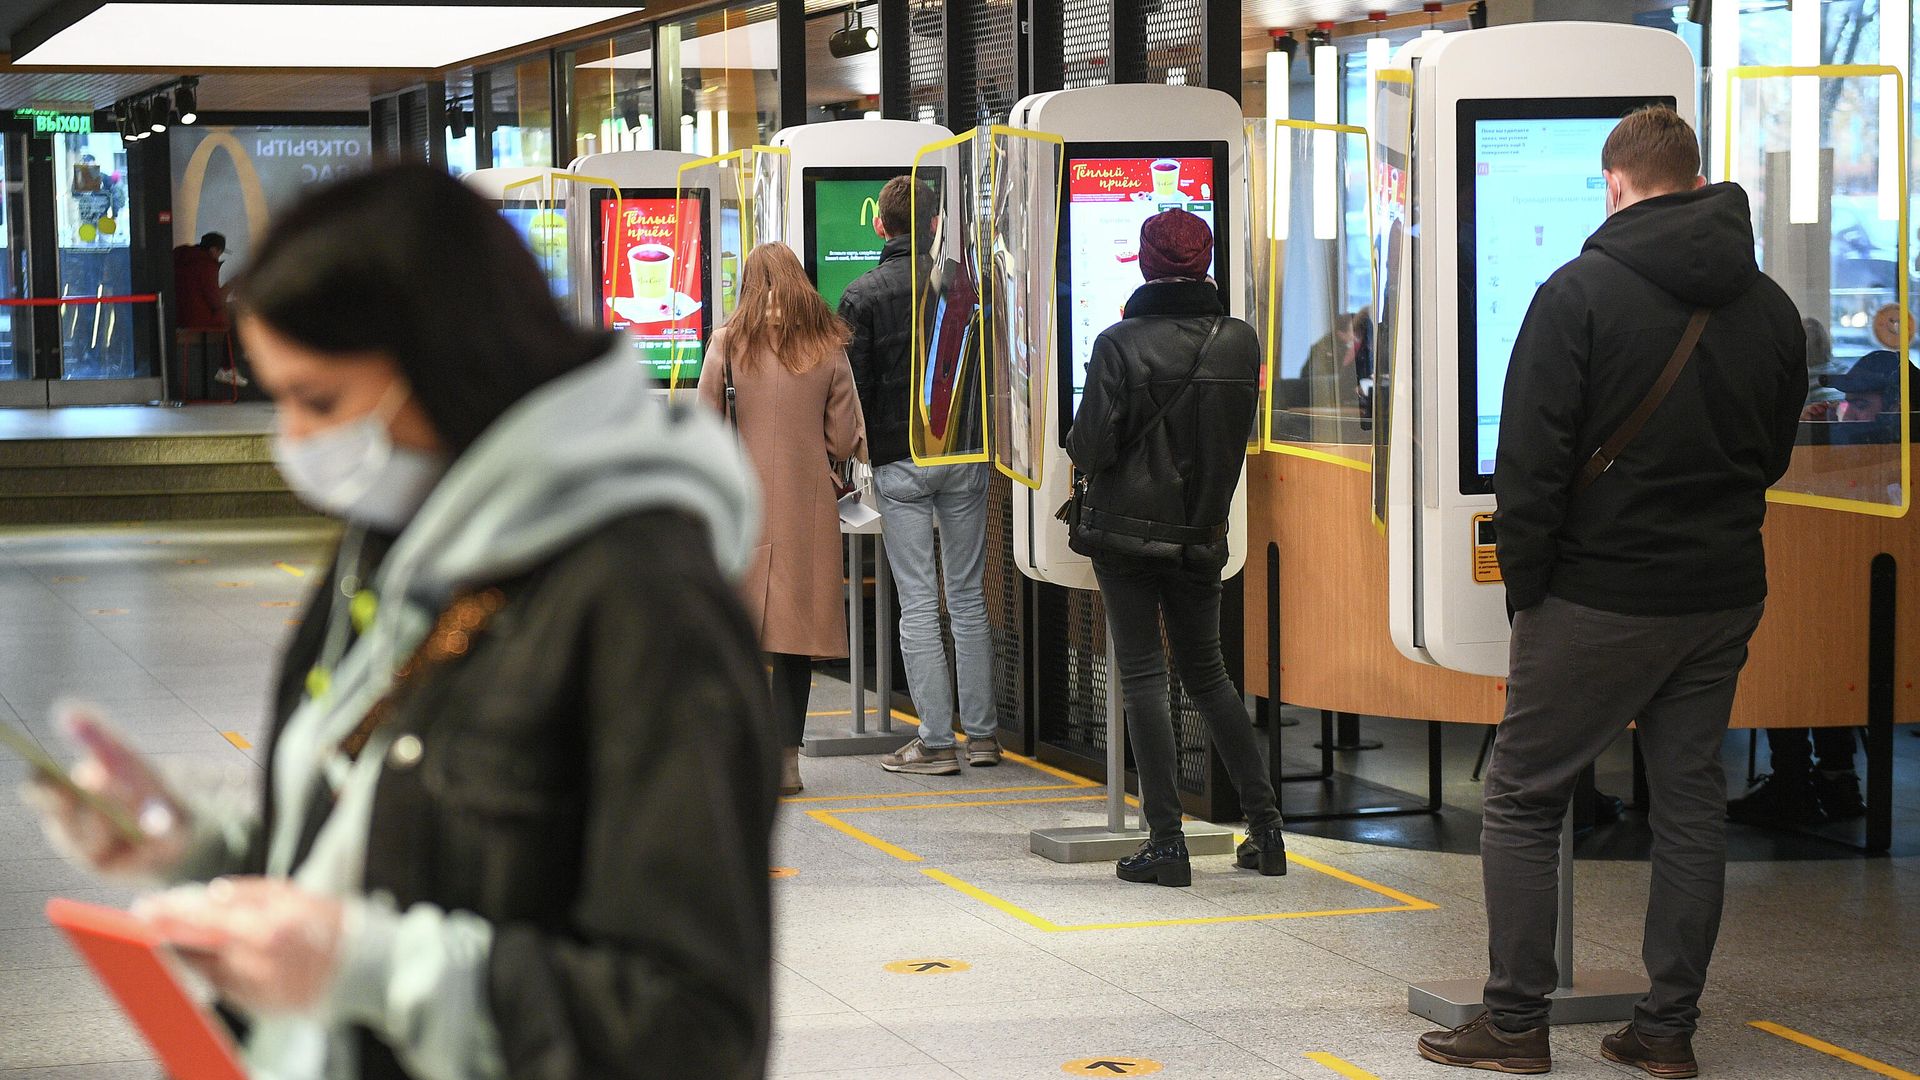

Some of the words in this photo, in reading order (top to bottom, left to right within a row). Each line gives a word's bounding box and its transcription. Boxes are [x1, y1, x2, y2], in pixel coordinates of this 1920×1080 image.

[36, 115, 92, 135] ВЫХОД
[1073, 164, 1124, 180] Тёплый
[1099, 177, 1141, 191] приём
[623, 211, 677, 227] Тёплый
[627, 226, 673, 241] приём
